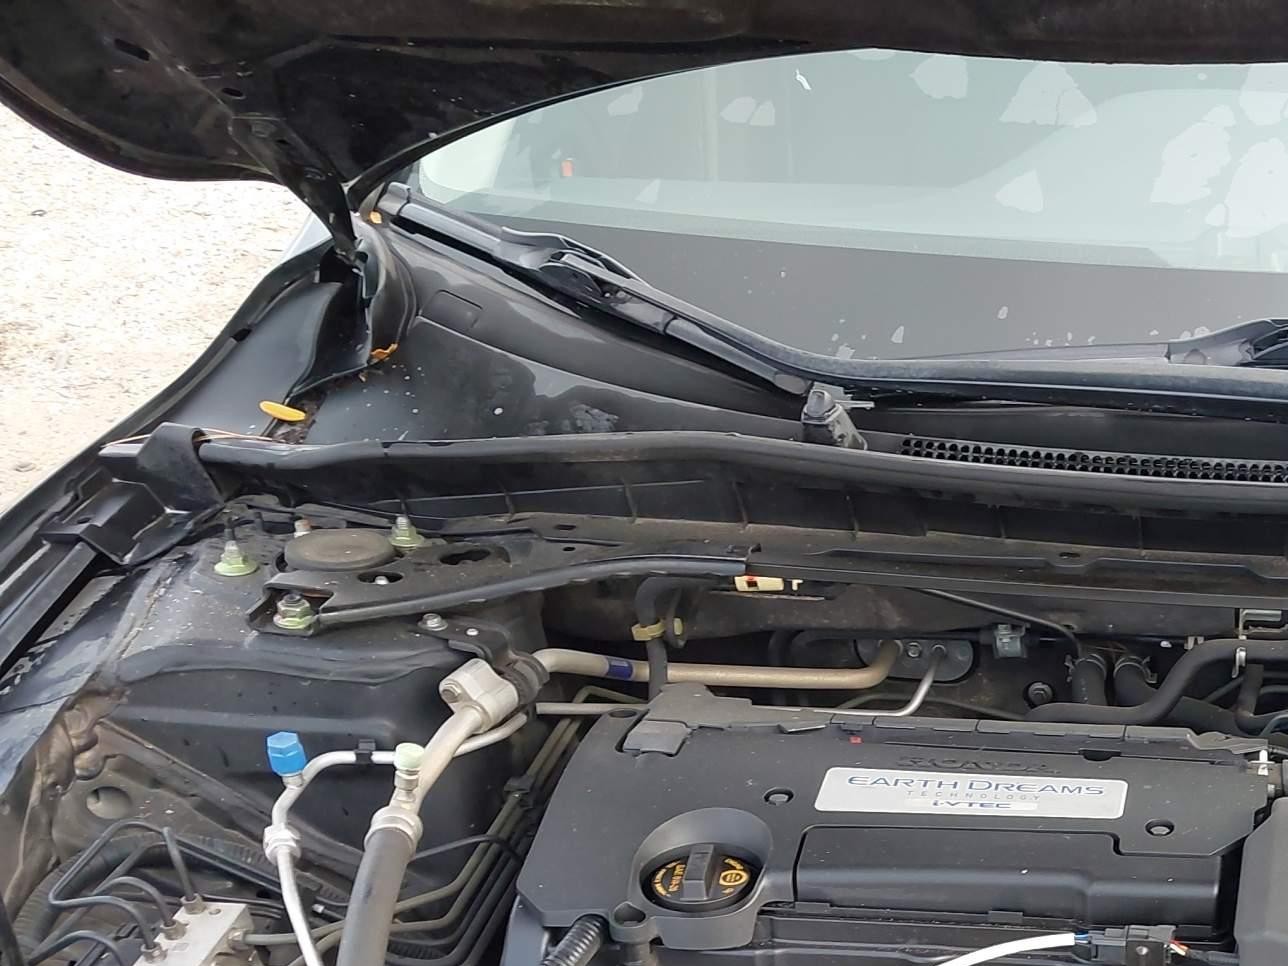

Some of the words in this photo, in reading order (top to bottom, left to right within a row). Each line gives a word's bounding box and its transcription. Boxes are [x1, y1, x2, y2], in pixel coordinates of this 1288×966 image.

[848, 776, 958, 789] EARTH
[967, 779, 1105, 795] DREAMS
[906, 790, 1041, 800] TECHNOLOGY
